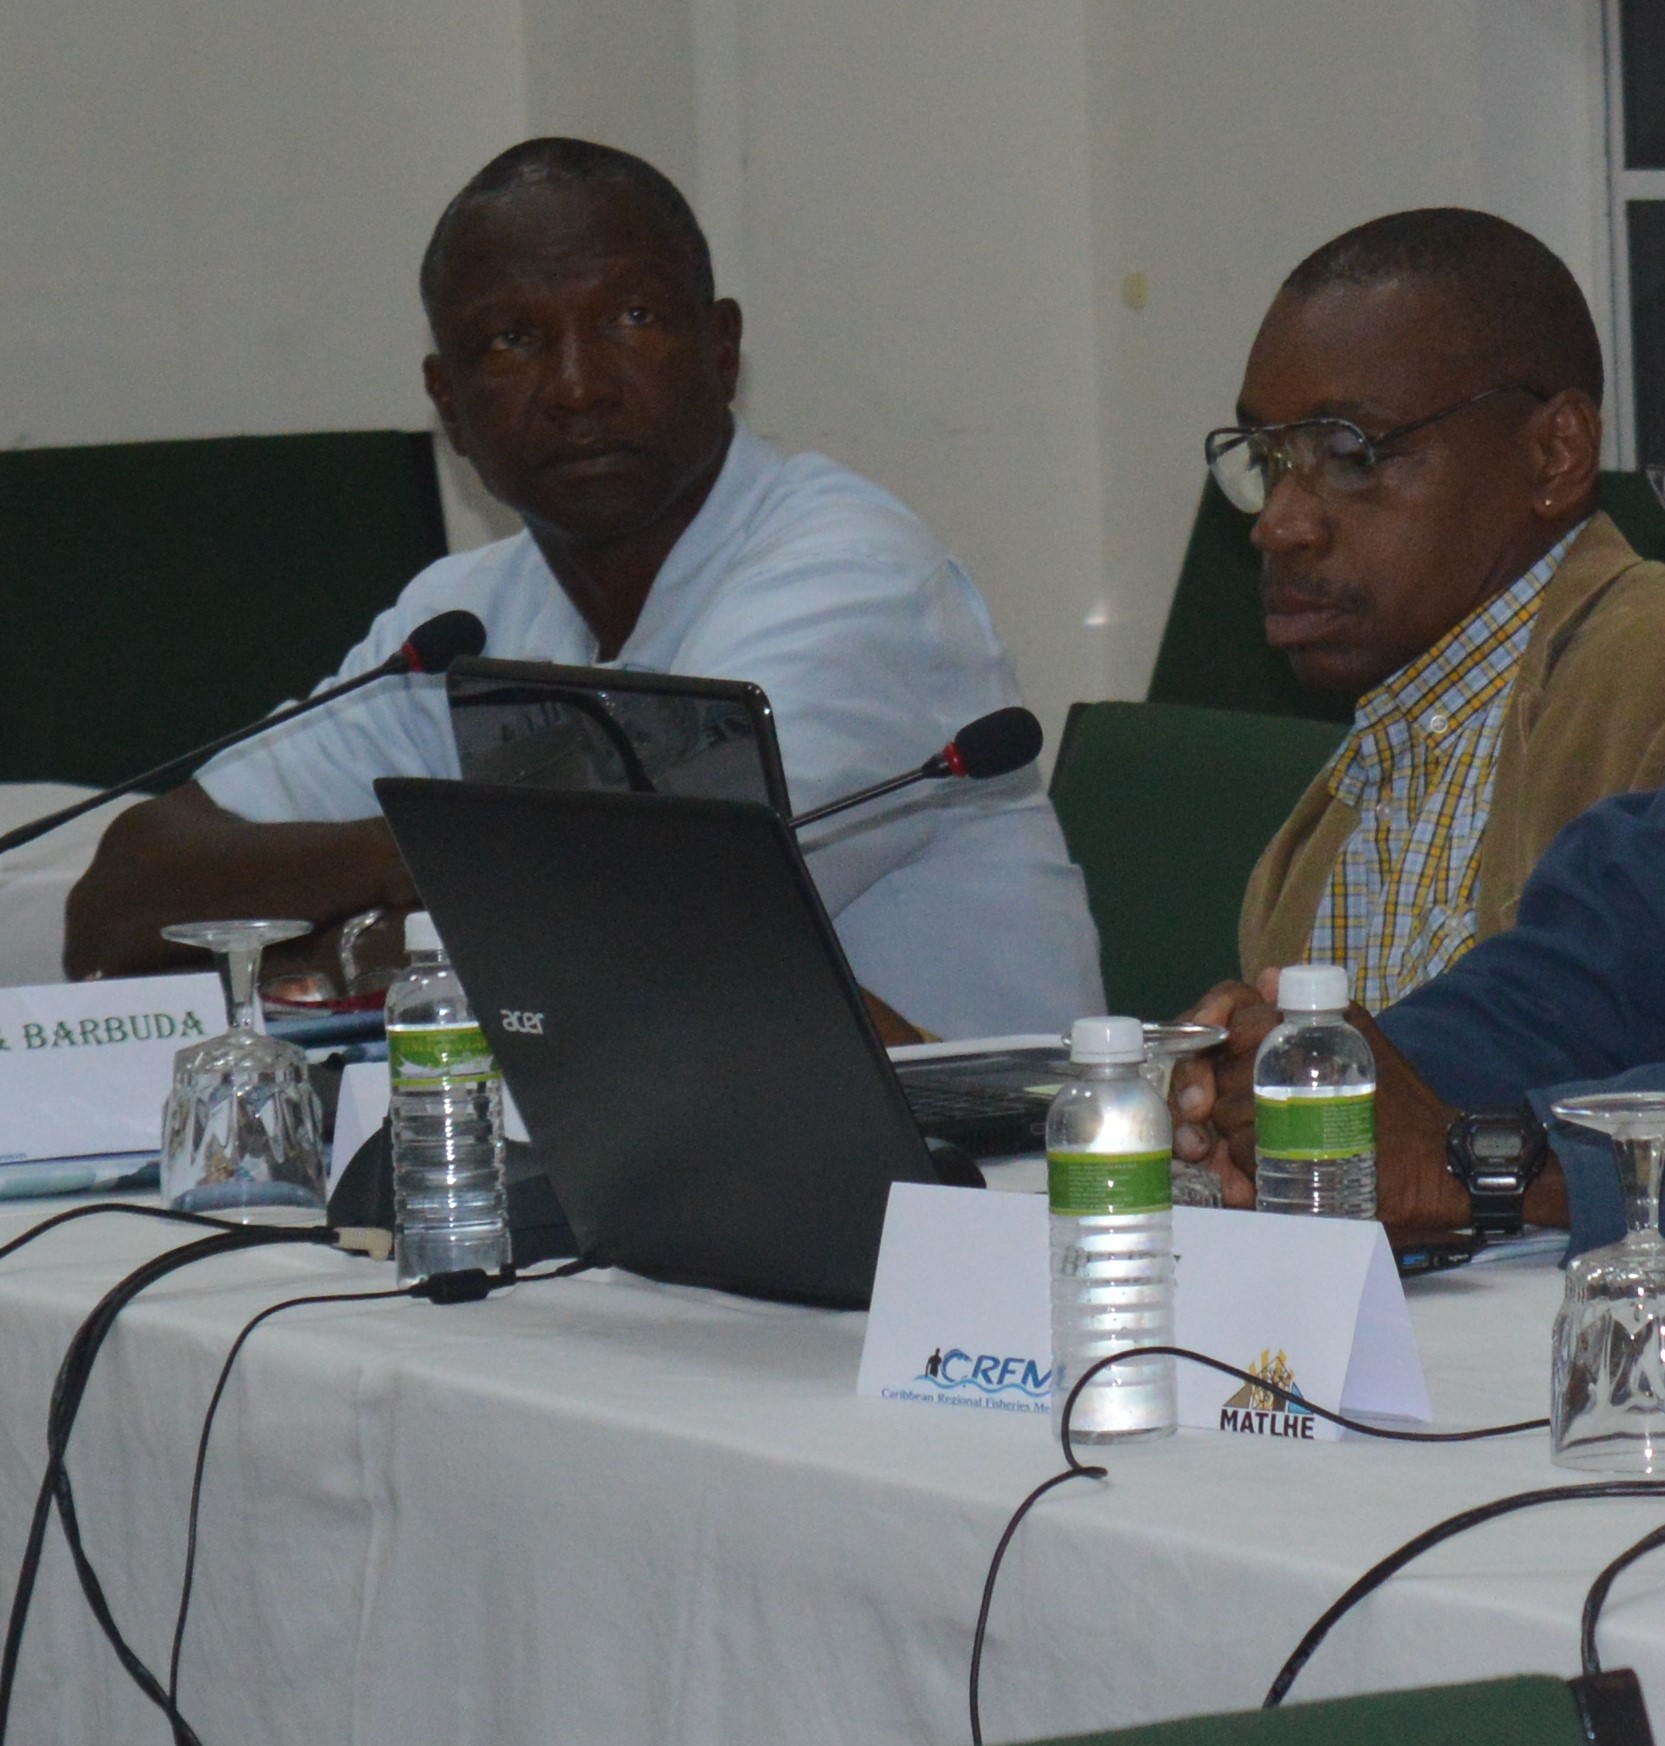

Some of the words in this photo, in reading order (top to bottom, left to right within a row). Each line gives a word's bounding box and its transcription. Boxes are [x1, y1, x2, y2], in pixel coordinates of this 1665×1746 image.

[22, 1010, 206, 1050] BARBUDA
[500, 1009, 544, 1035] acer
[881, 1388, 934, 1402] Caribbean
[938, 1393, 982, 1408] Regional
[985, 1397, 1030, 1413] Fisheries
[1220, 1408, 1314, 1440] MATLHE
